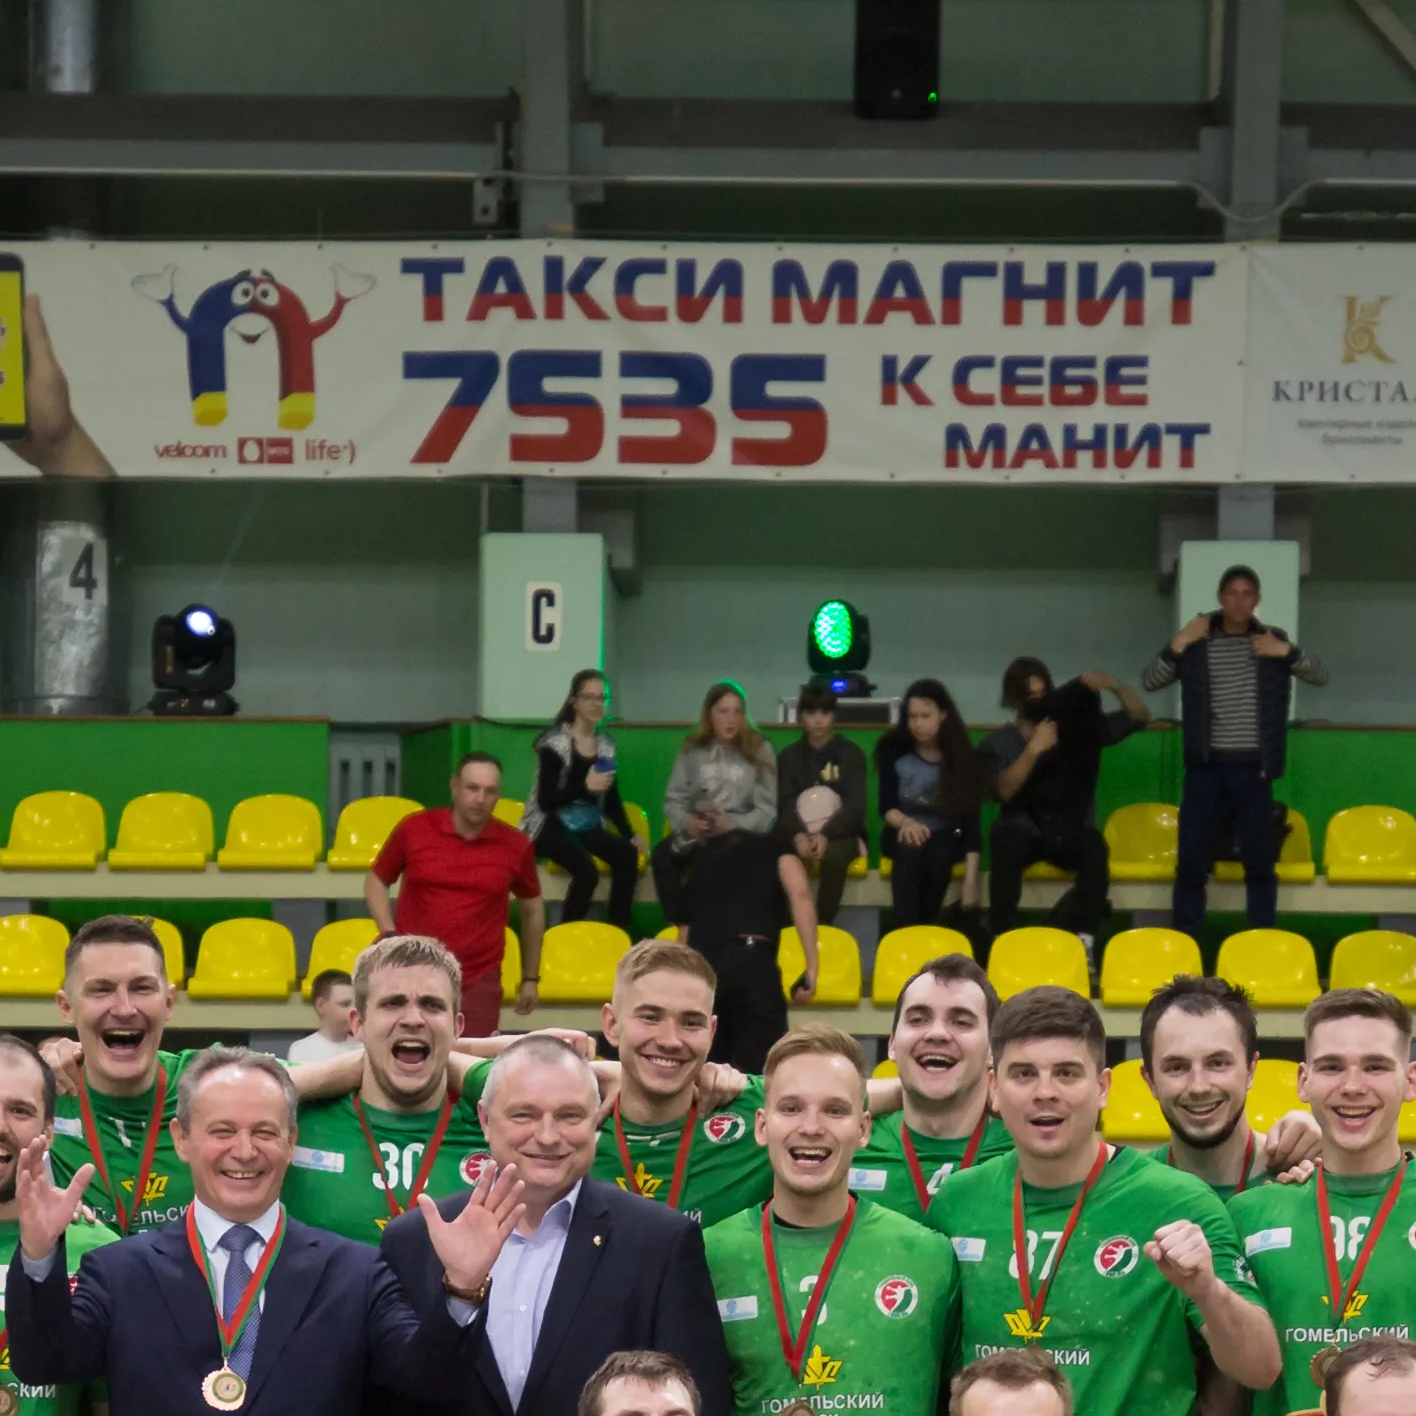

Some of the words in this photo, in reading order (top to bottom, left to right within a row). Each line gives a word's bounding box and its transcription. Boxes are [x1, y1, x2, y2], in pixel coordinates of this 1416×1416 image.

[400, 255, 744, 323] ТАКСИ
[772, 259, 1217, 327] МАГНИТ
[401, 349, 829, 467] 7535
[881, 354, 934, 406] К
[953, 355, 1149, 406] СЕБЕ
[944, 423, 1211, 470] МАНИТ
[69, 543, 97, 600] 4
